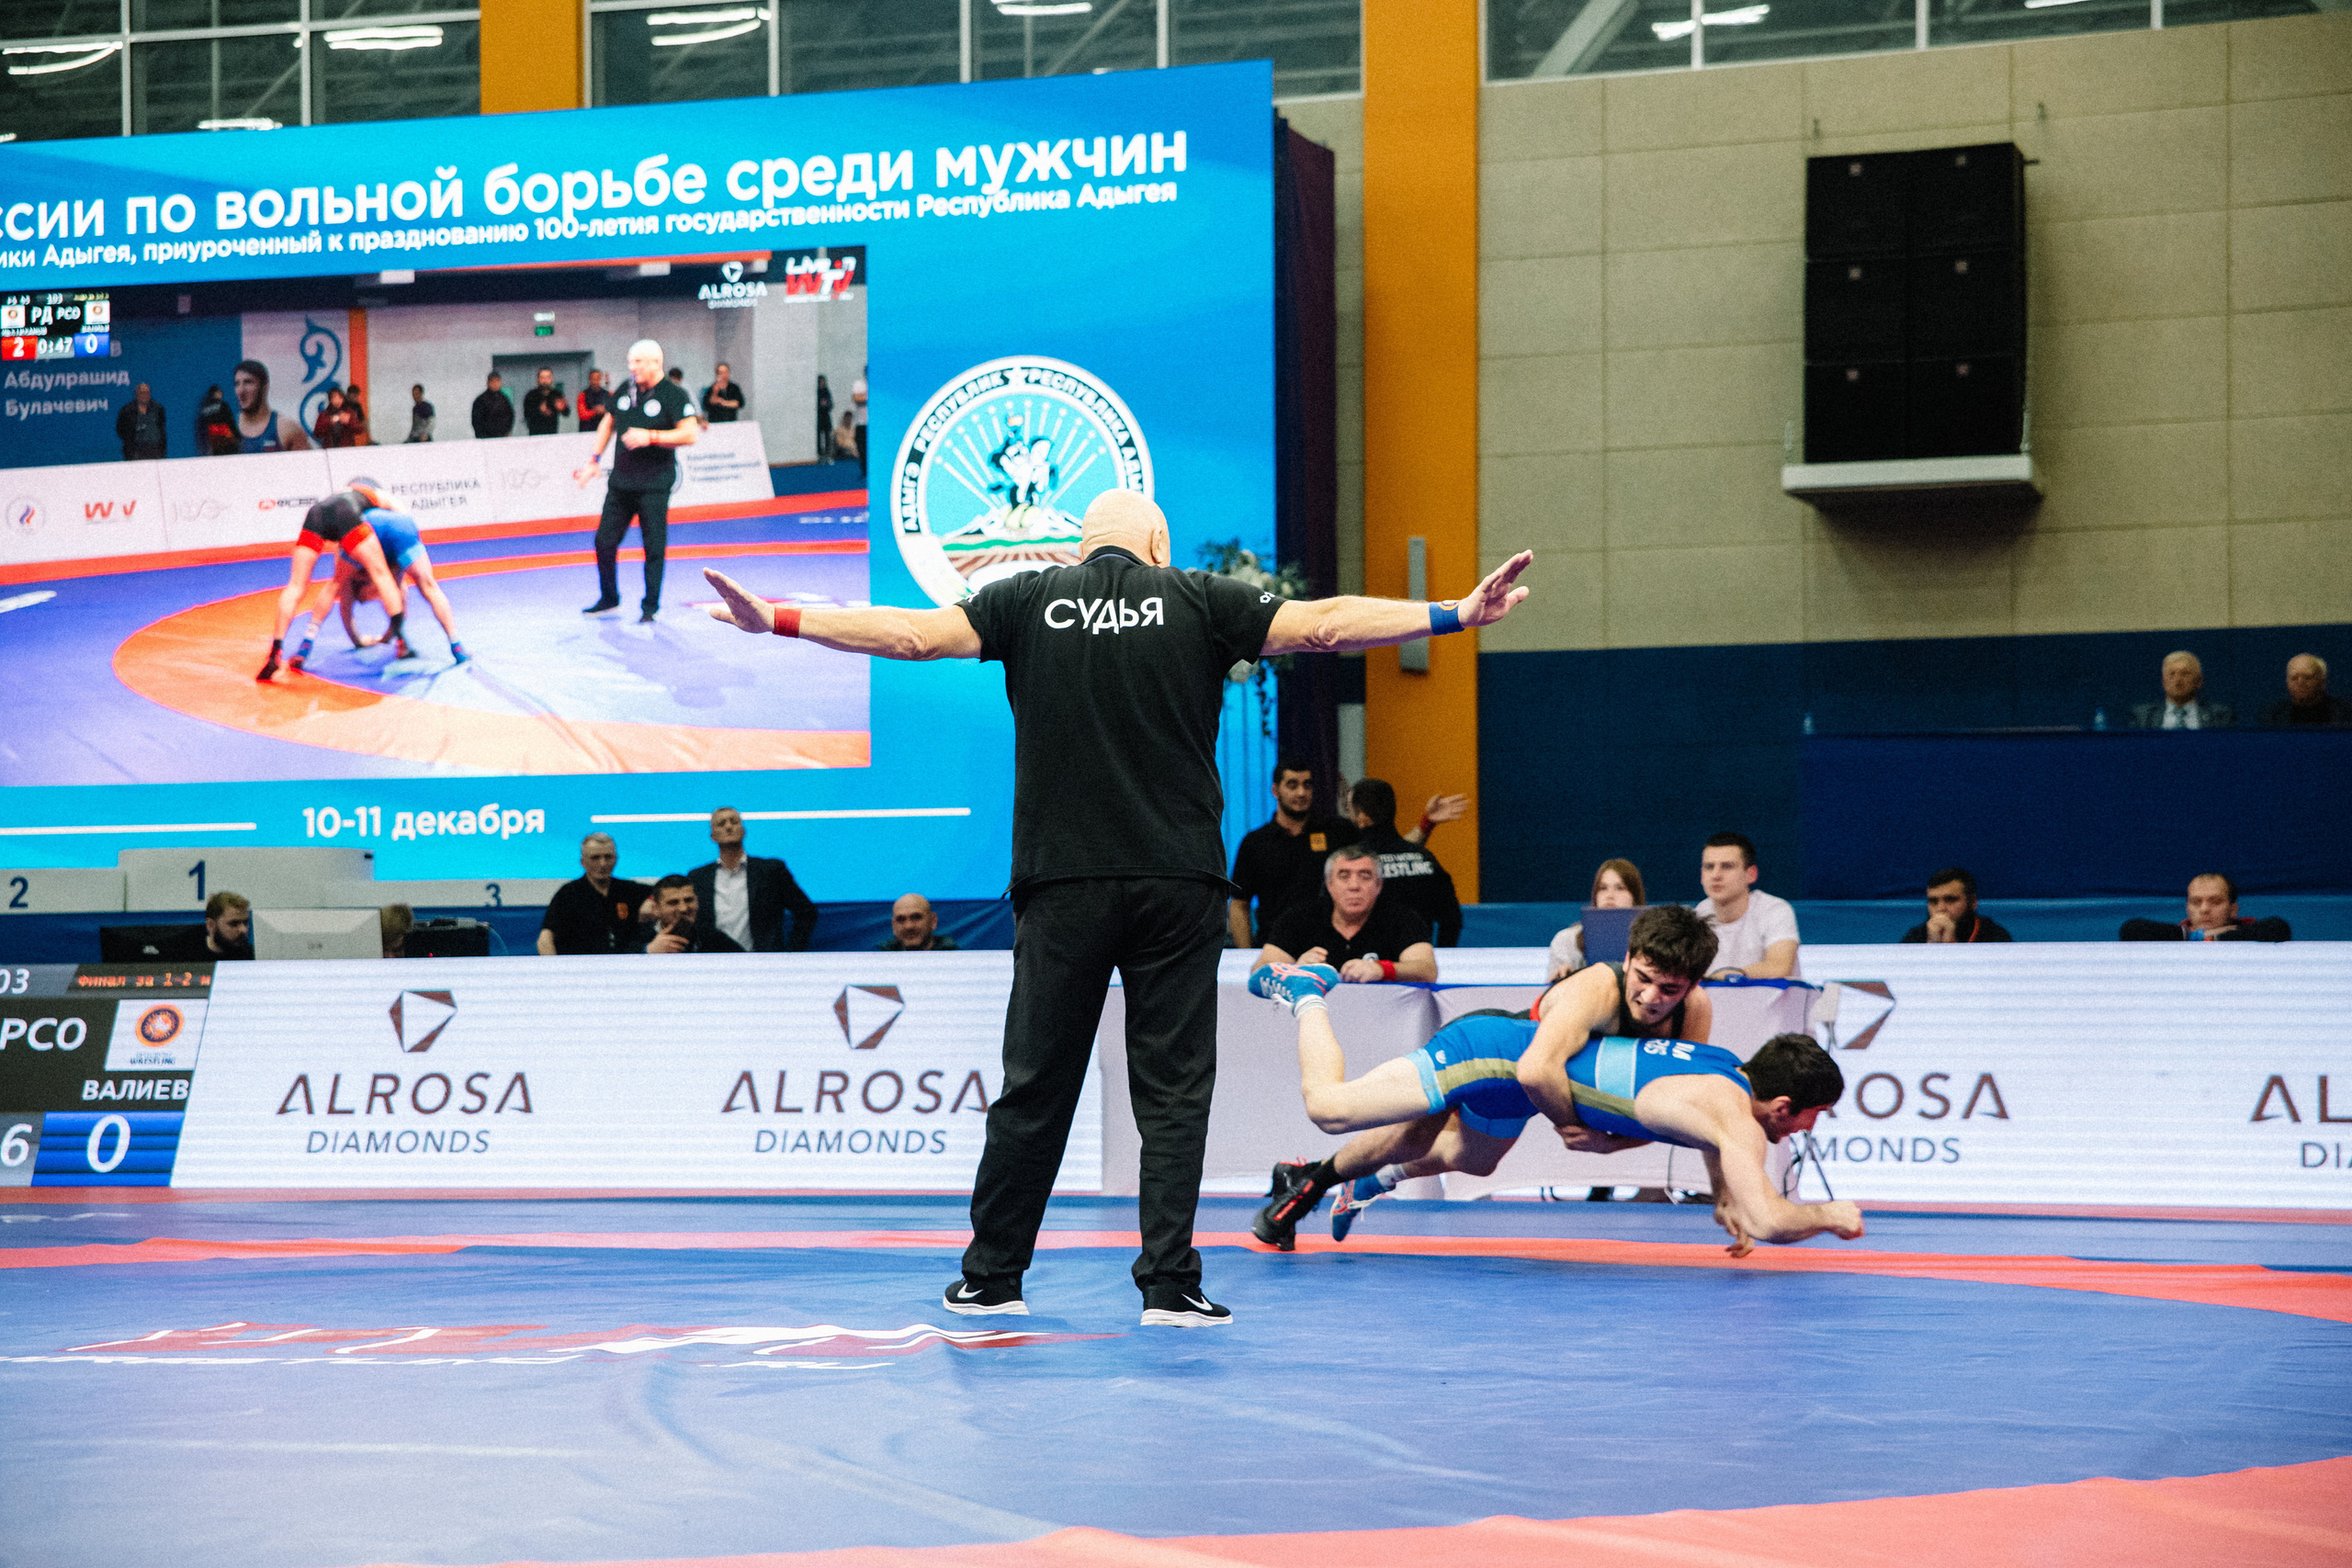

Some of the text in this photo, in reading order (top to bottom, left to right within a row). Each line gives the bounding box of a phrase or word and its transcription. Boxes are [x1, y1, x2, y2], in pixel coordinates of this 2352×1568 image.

[0, 130, 1187, 241] сии по вольной борьбе среди мужчин
[42, 243, 137, 268] Адыгея,
[143, 230, 322, 265] приуроченный
[328, 233, 344, 252] к
[348, 223, 529, 254] празднованию
[534, 215, 660, 240] 100-летия
[665, 199, 910, 234] государственности
[917, 188, 1070, 218] Республика
[1076, 182, 1177, 210] Адыгея
[697, 281, 768, 300] ALROSA
[30, 305, 53, 325] РД
[12, 336, 25, 357] 2
[37, 336, 74, 355] 0:47
[85, 333, 98, 354] 0
[4, 369, 130, 392] Абдулрашид
[5, 398, 109, 421] Булачевич
[1044, 597, 1164, 635] СУДЬЯ
[302, 803, 545, 840] 10-11 декабря
[9, 876, 28, 908] 2
[188, 860, 206, 901] 1
[485, 883, 503, 907] 3
[164, 972, 192, 987] 1-2
[82, 1079, 190, 1101] ВАЛИЕВ
[275, 1071, 534, 1115] ALROSA
[721, 1070, 989, 1113] ALROSA
[1826, 1071, 2009, 1120] OSA
[87, 1114, 131, 1173] 0
[306, 1130, 491, 1154] DIAMONDS
[754, 1130, 947, 1154] DIAMONDS
[2301, 1141, 2352, 1168] DI
